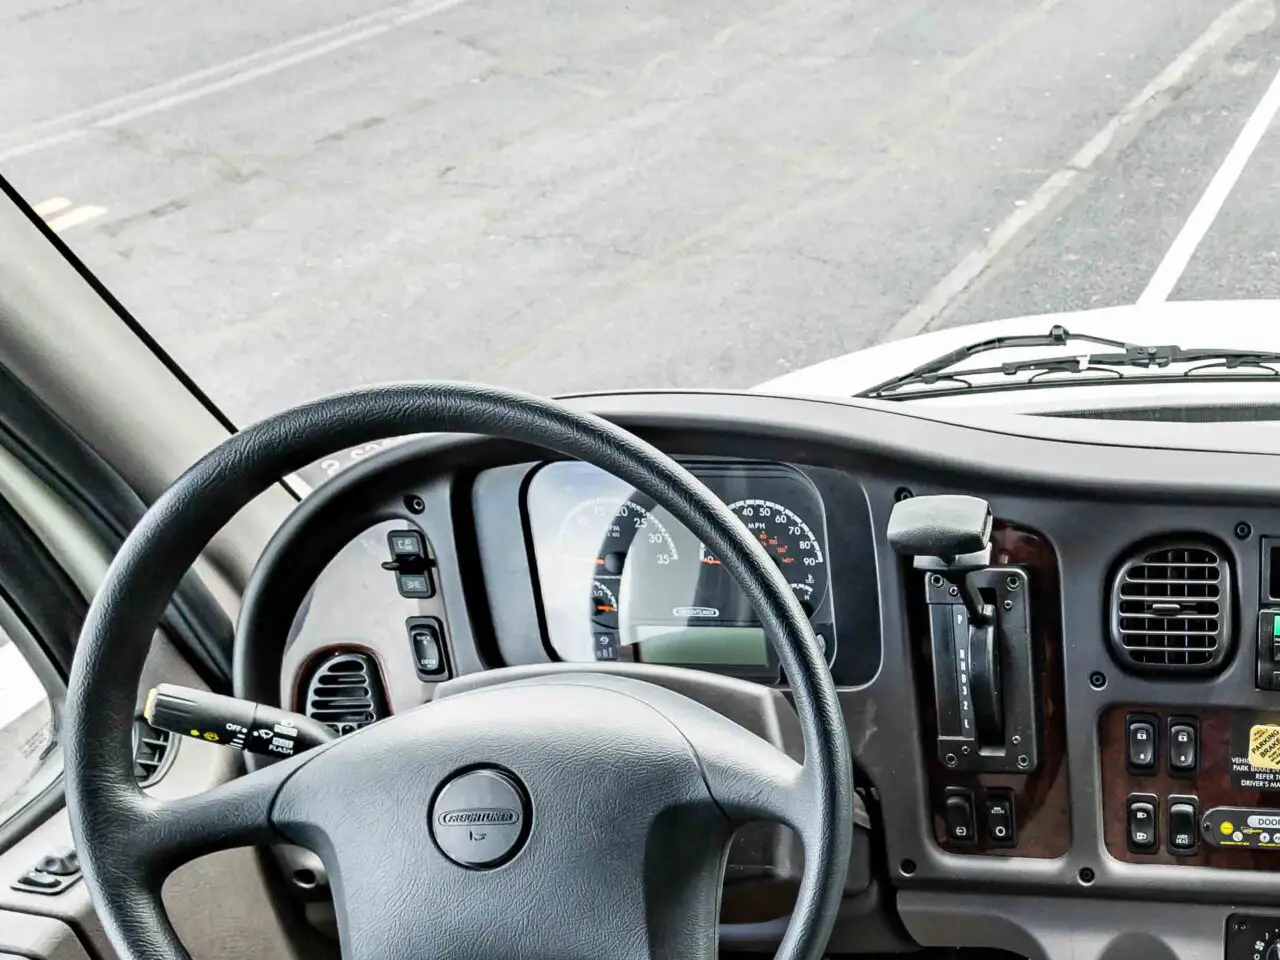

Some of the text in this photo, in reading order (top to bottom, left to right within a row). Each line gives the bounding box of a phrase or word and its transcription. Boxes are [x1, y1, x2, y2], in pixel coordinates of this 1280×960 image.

[742, 508, 753, 517] 40
[760, 508, 770, 517] 50
[634, 518, 647, 528] 25
[775, 515, 787, 524] 60
[789, 526, 801, 535] 70
[648, 533, 662, 543] 30
[799, 541, 811, 550] 80
[657, 554, 670, 564] 35
[803, 557, 816, 566] 90
[963, 701, 968, 710] 2
[1251, 729, 1280, 754] PARKING
